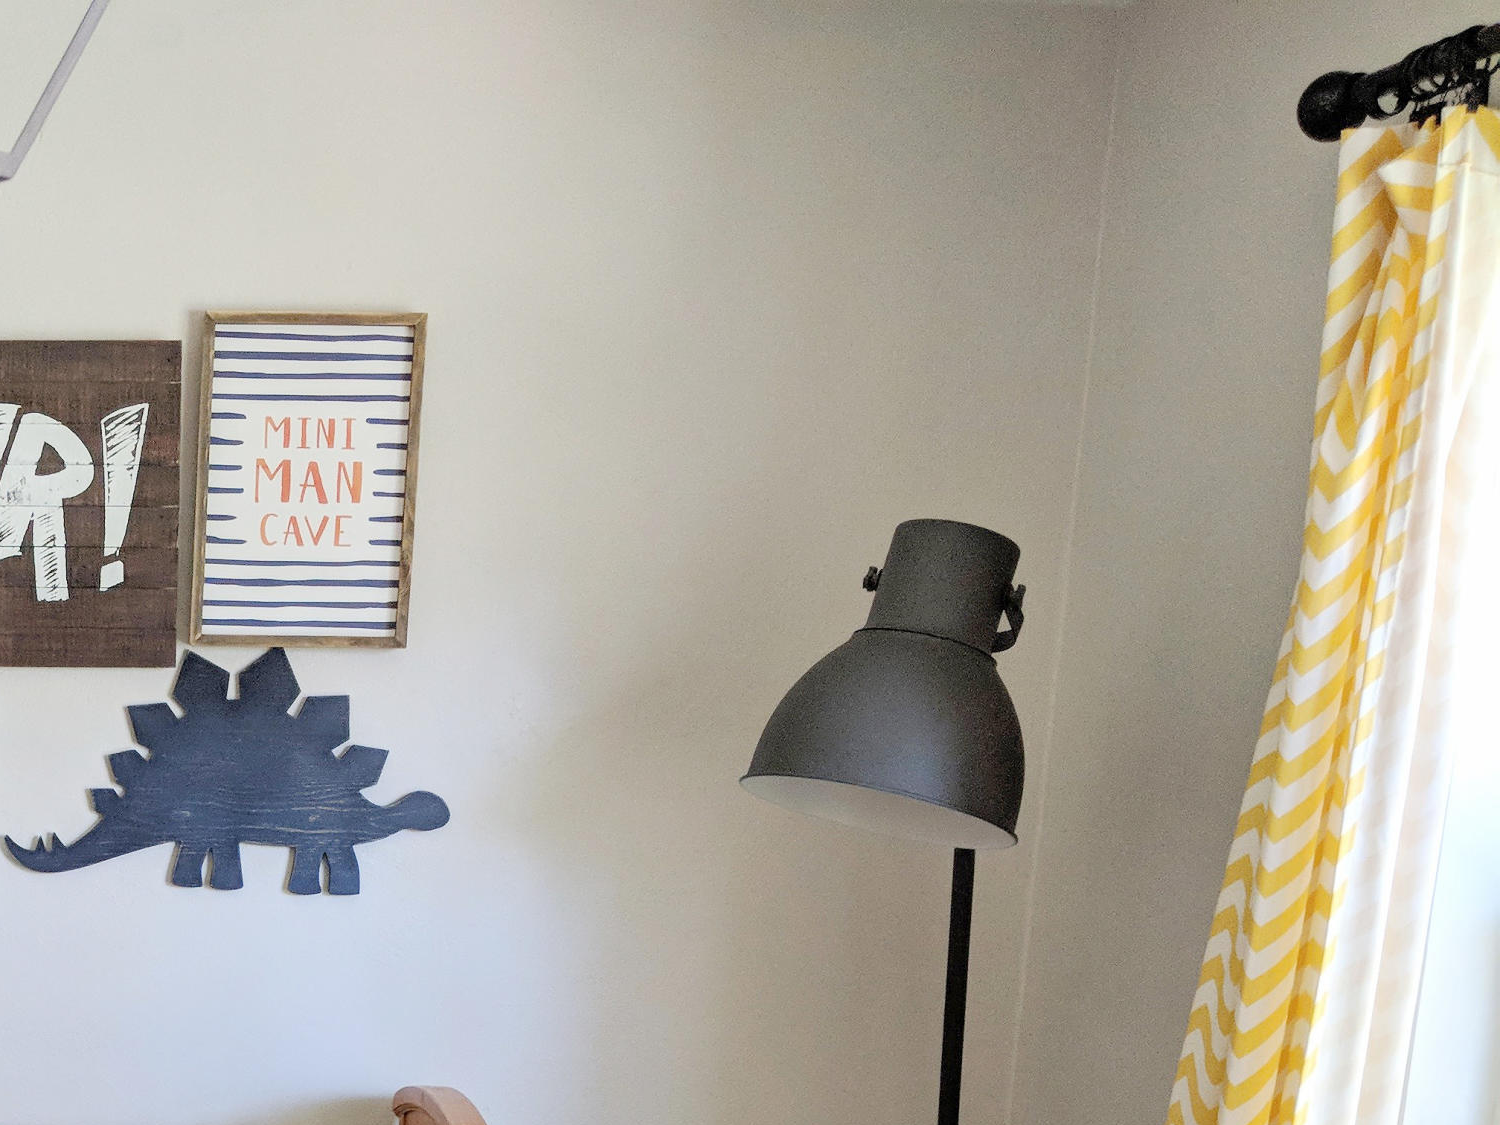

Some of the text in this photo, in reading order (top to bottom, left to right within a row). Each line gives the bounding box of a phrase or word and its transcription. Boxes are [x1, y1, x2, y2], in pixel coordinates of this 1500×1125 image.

[264, 415, 356, 450] MINI
[254, 458, 363, 505] MAN
[260, 513, 353, 547] CAVE
